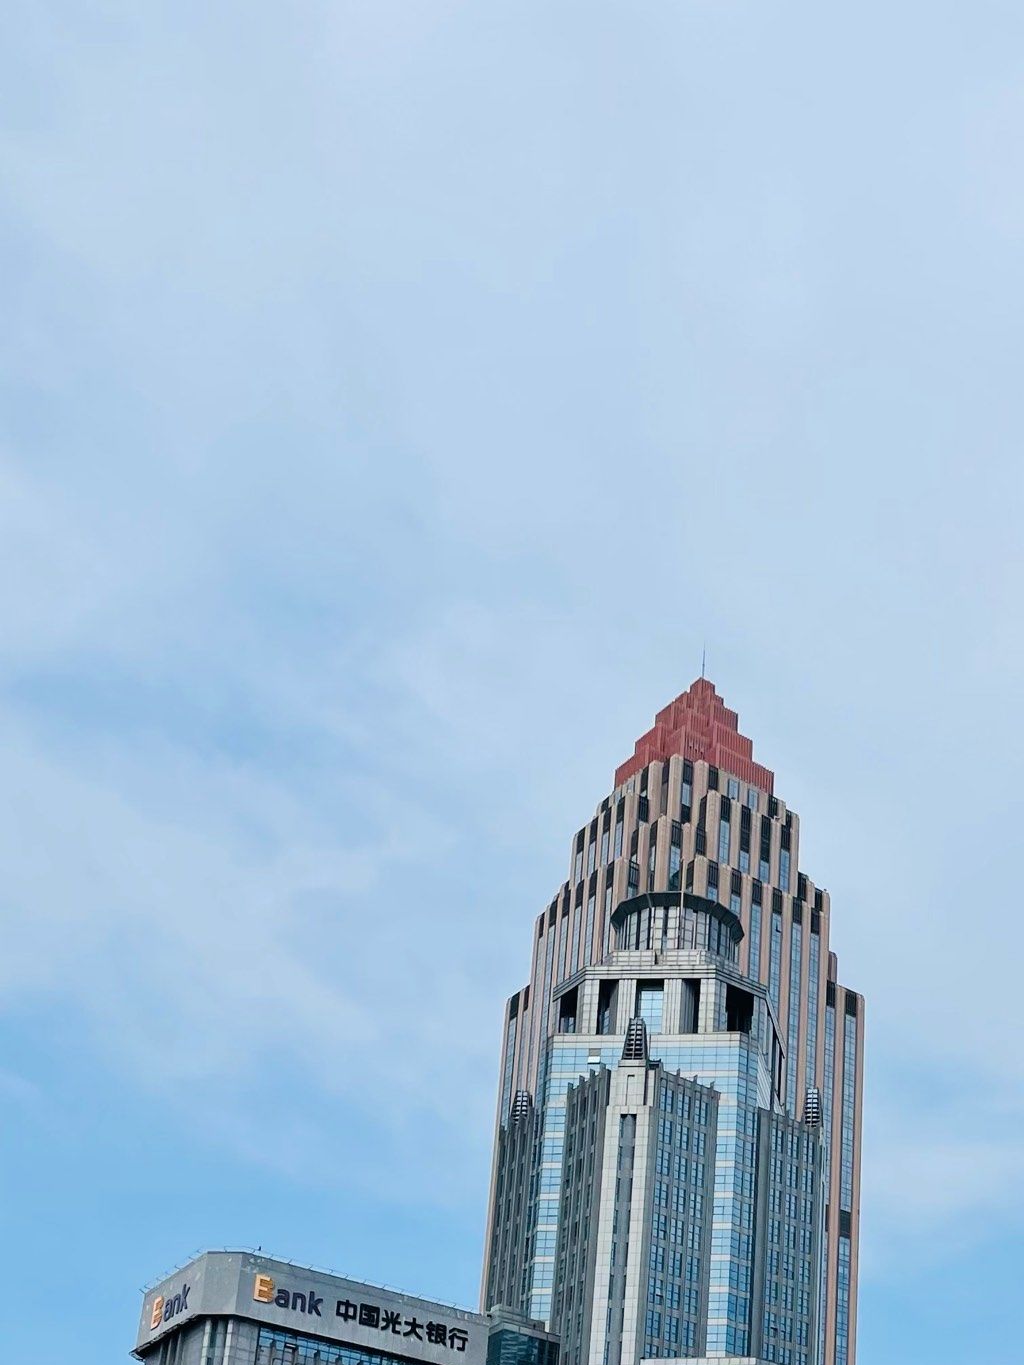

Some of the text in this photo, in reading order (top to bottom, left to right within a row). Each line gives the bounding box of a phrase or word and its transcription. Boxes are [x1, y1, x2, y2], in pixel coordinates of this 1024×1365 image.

[336, 1299, 469, 1352] 中国光大银行
